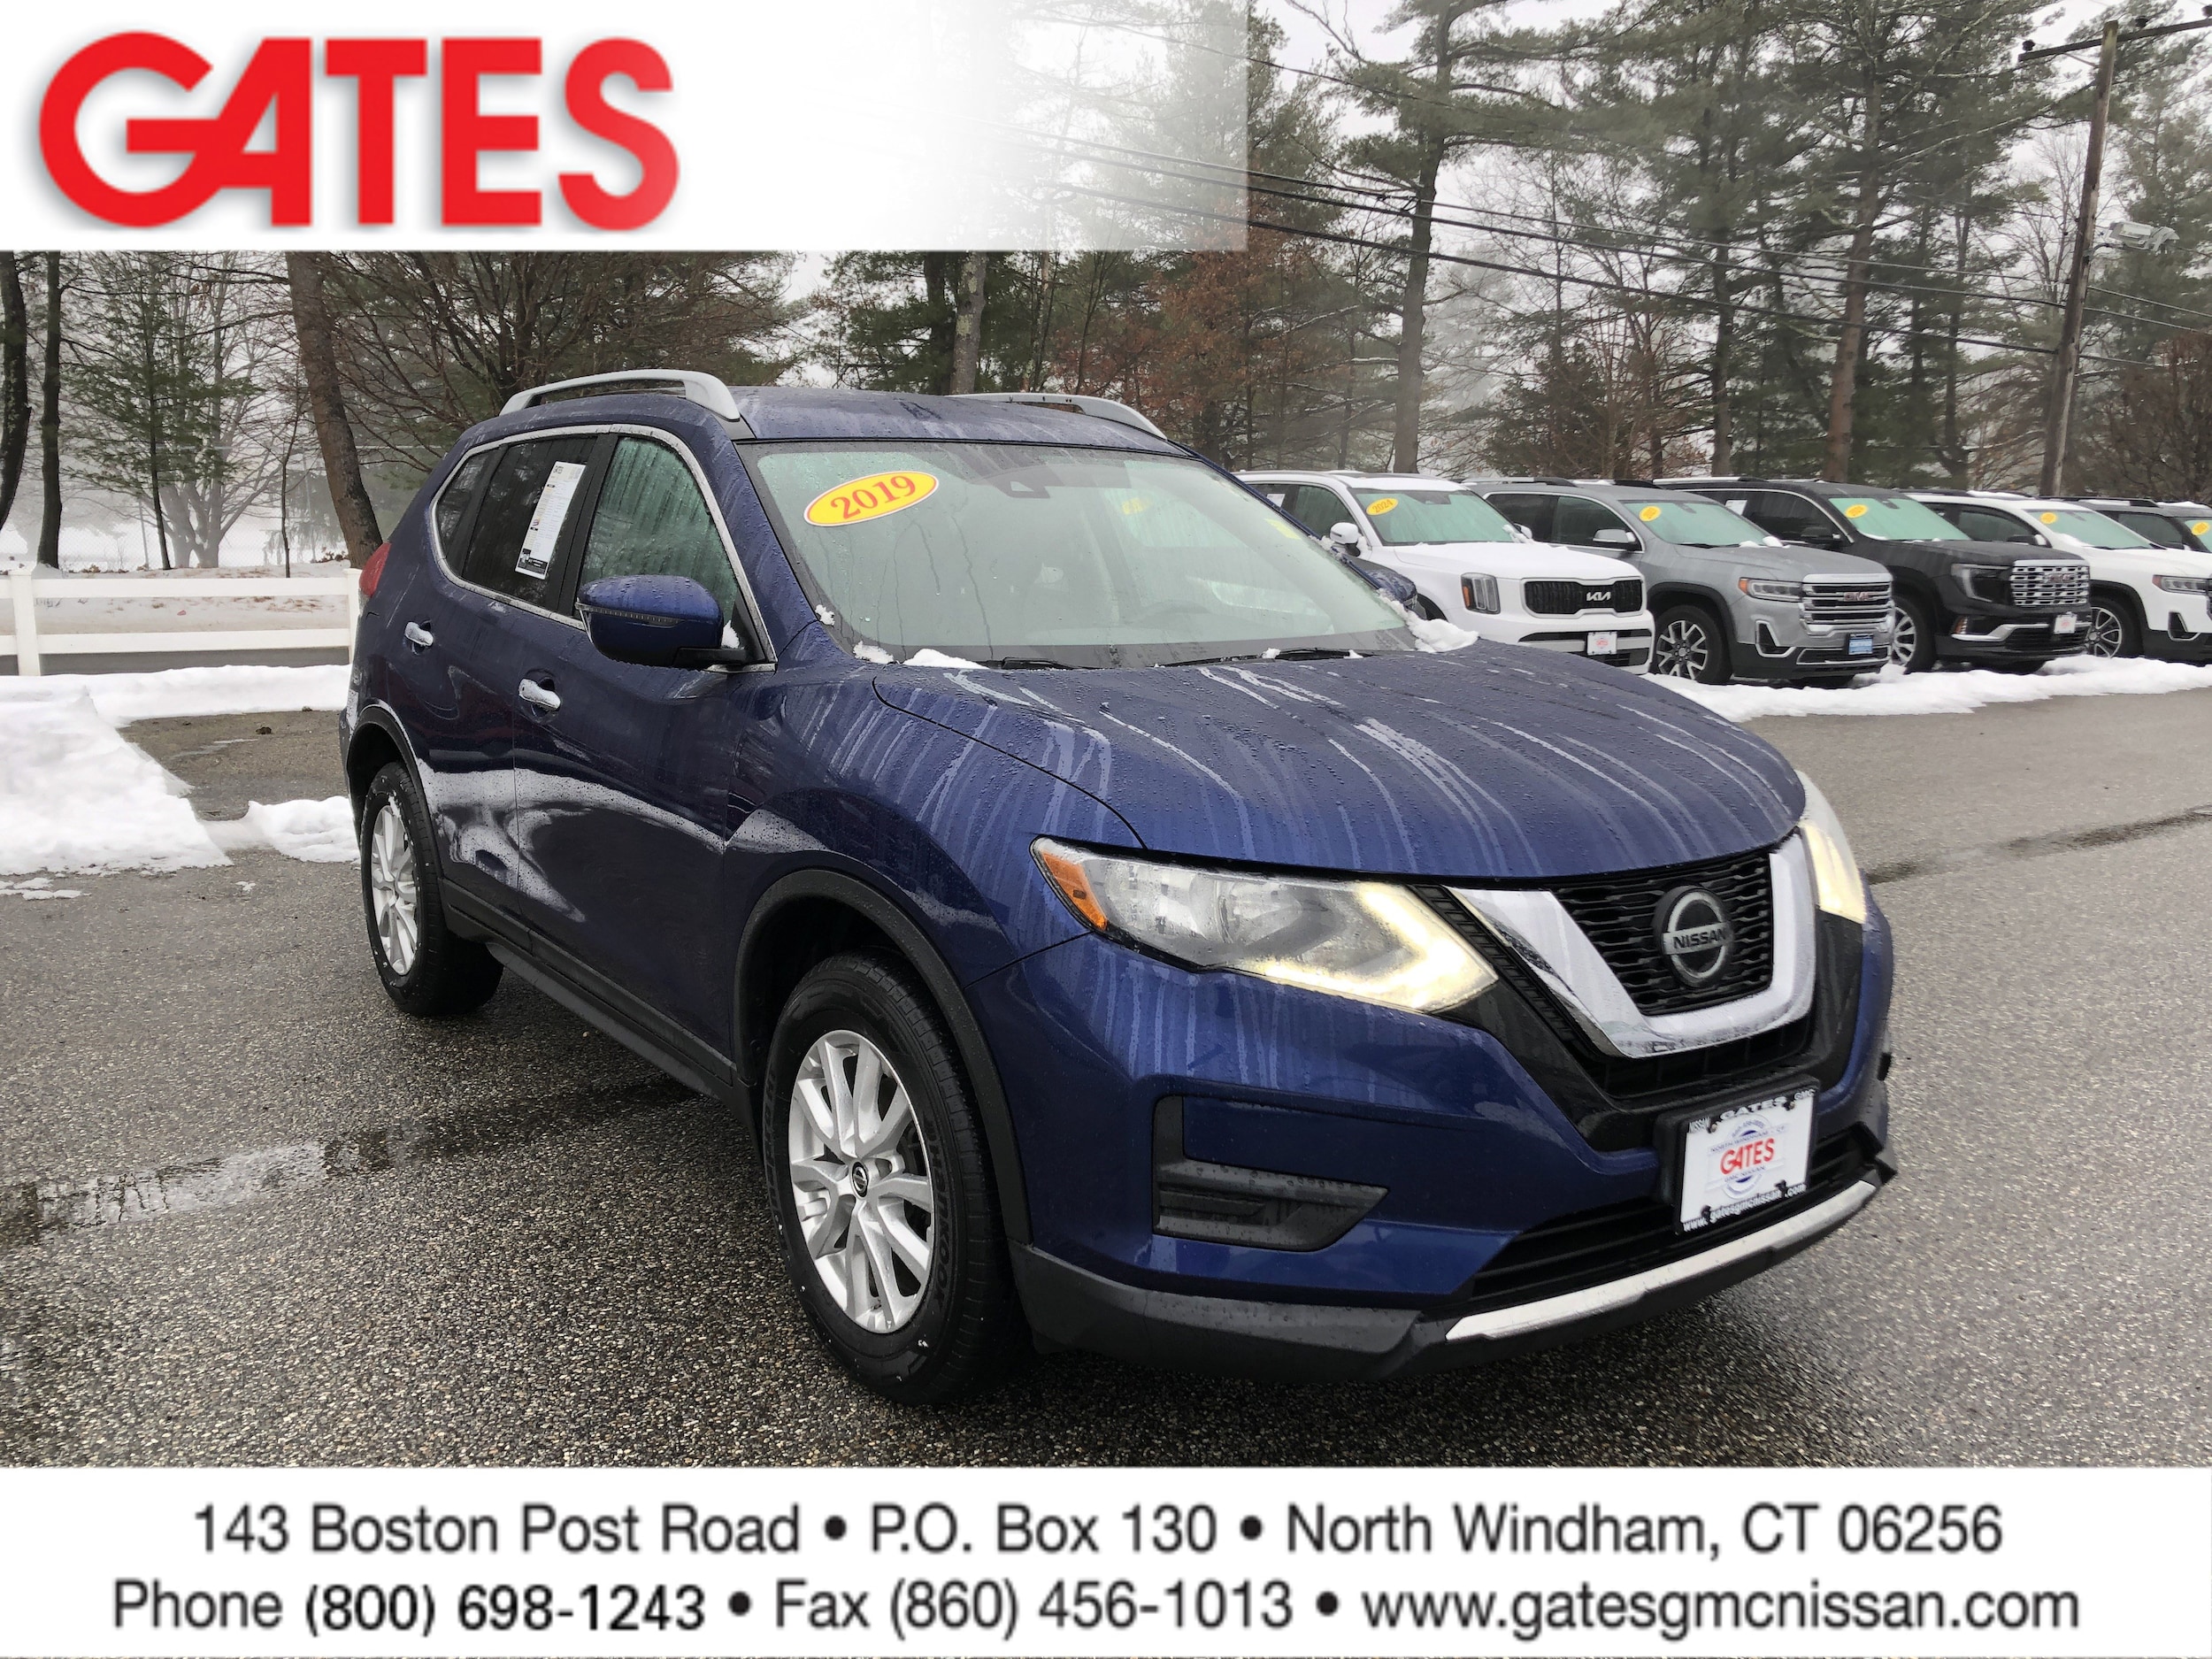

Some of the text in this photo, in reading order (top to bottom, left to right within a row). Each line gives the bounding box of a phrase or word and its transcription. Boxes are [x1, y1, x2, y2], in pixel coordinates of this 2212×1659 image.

[830, 475, 916, 519] 2019
[1371, 499, 1394, 513] 2024
[1586, 591, 1611, 601] KIA
[1672, 928, 1726, 949] NISSAN
[1720, 1095, 1787, 1120] GATES
[1720, 1138, 1775, 1175] GATES
